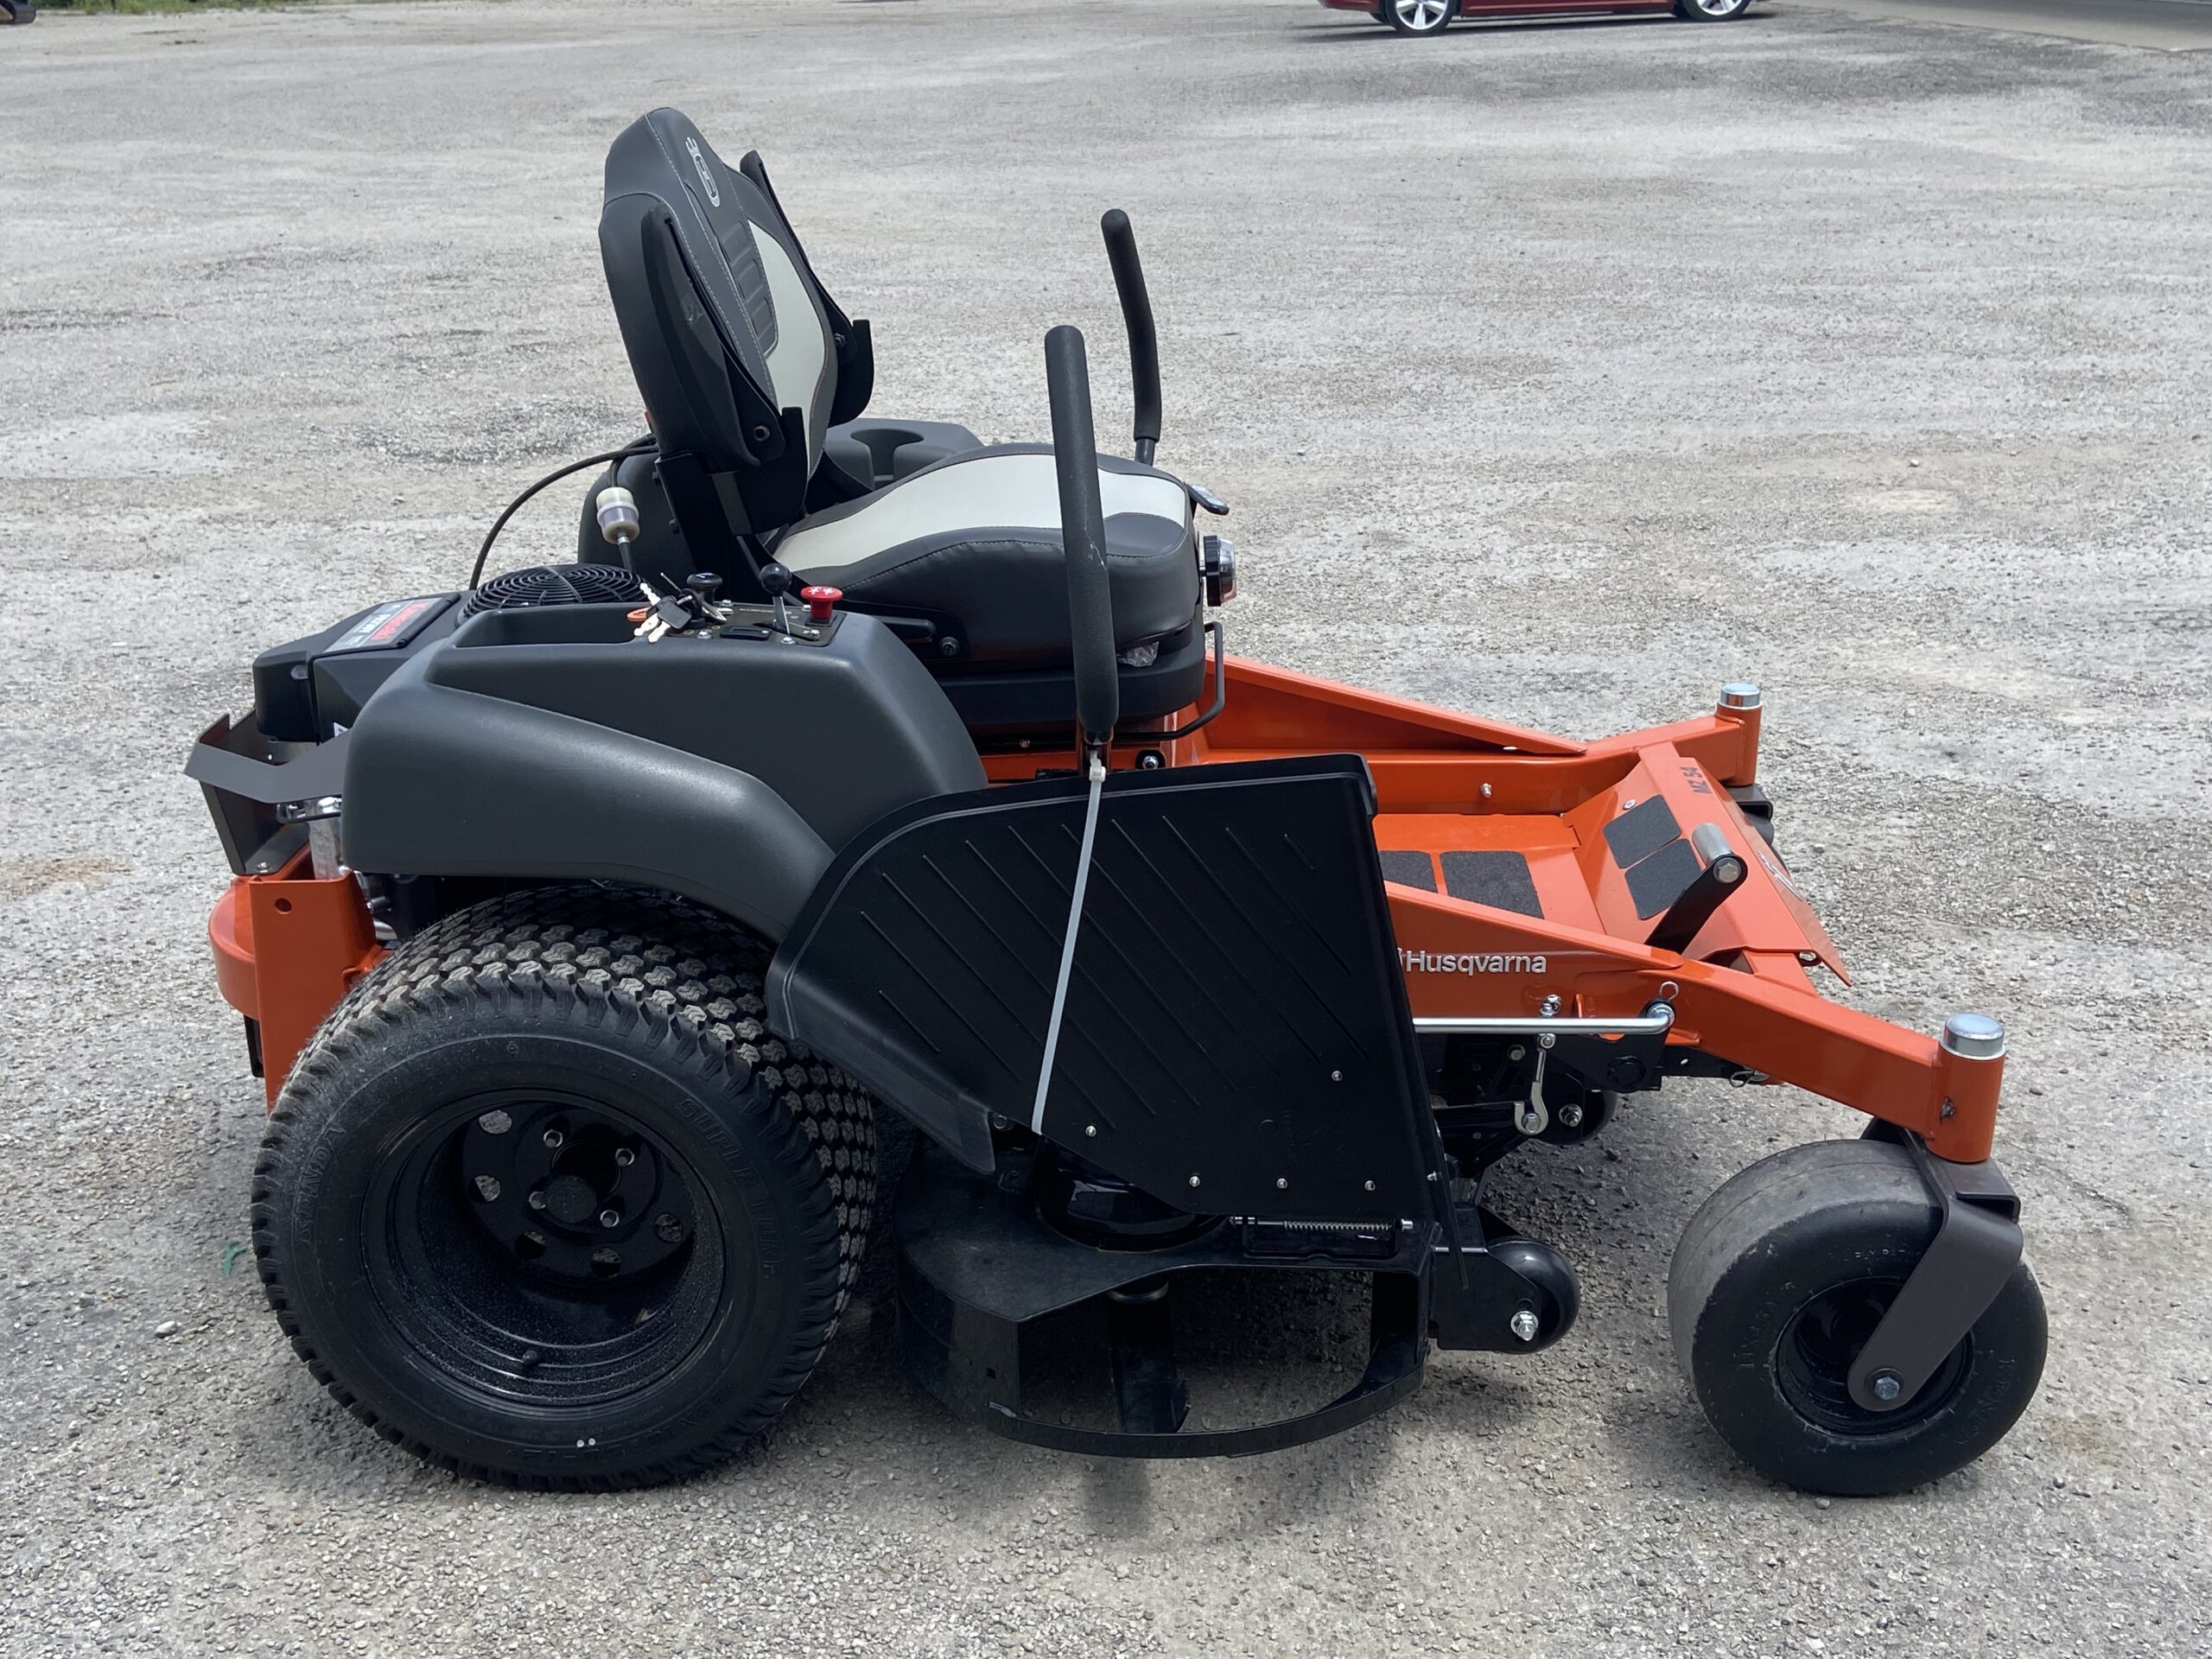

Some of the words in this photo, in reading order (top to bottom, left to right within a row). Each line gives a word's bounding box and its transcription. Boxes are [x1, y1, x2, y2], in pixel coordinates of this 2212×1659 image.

[1407, 950, 1547, 976] Husqvarna
[295, 1127, 346, 1245] KENDA
[676, 1097, 759, 1186] SUPER
